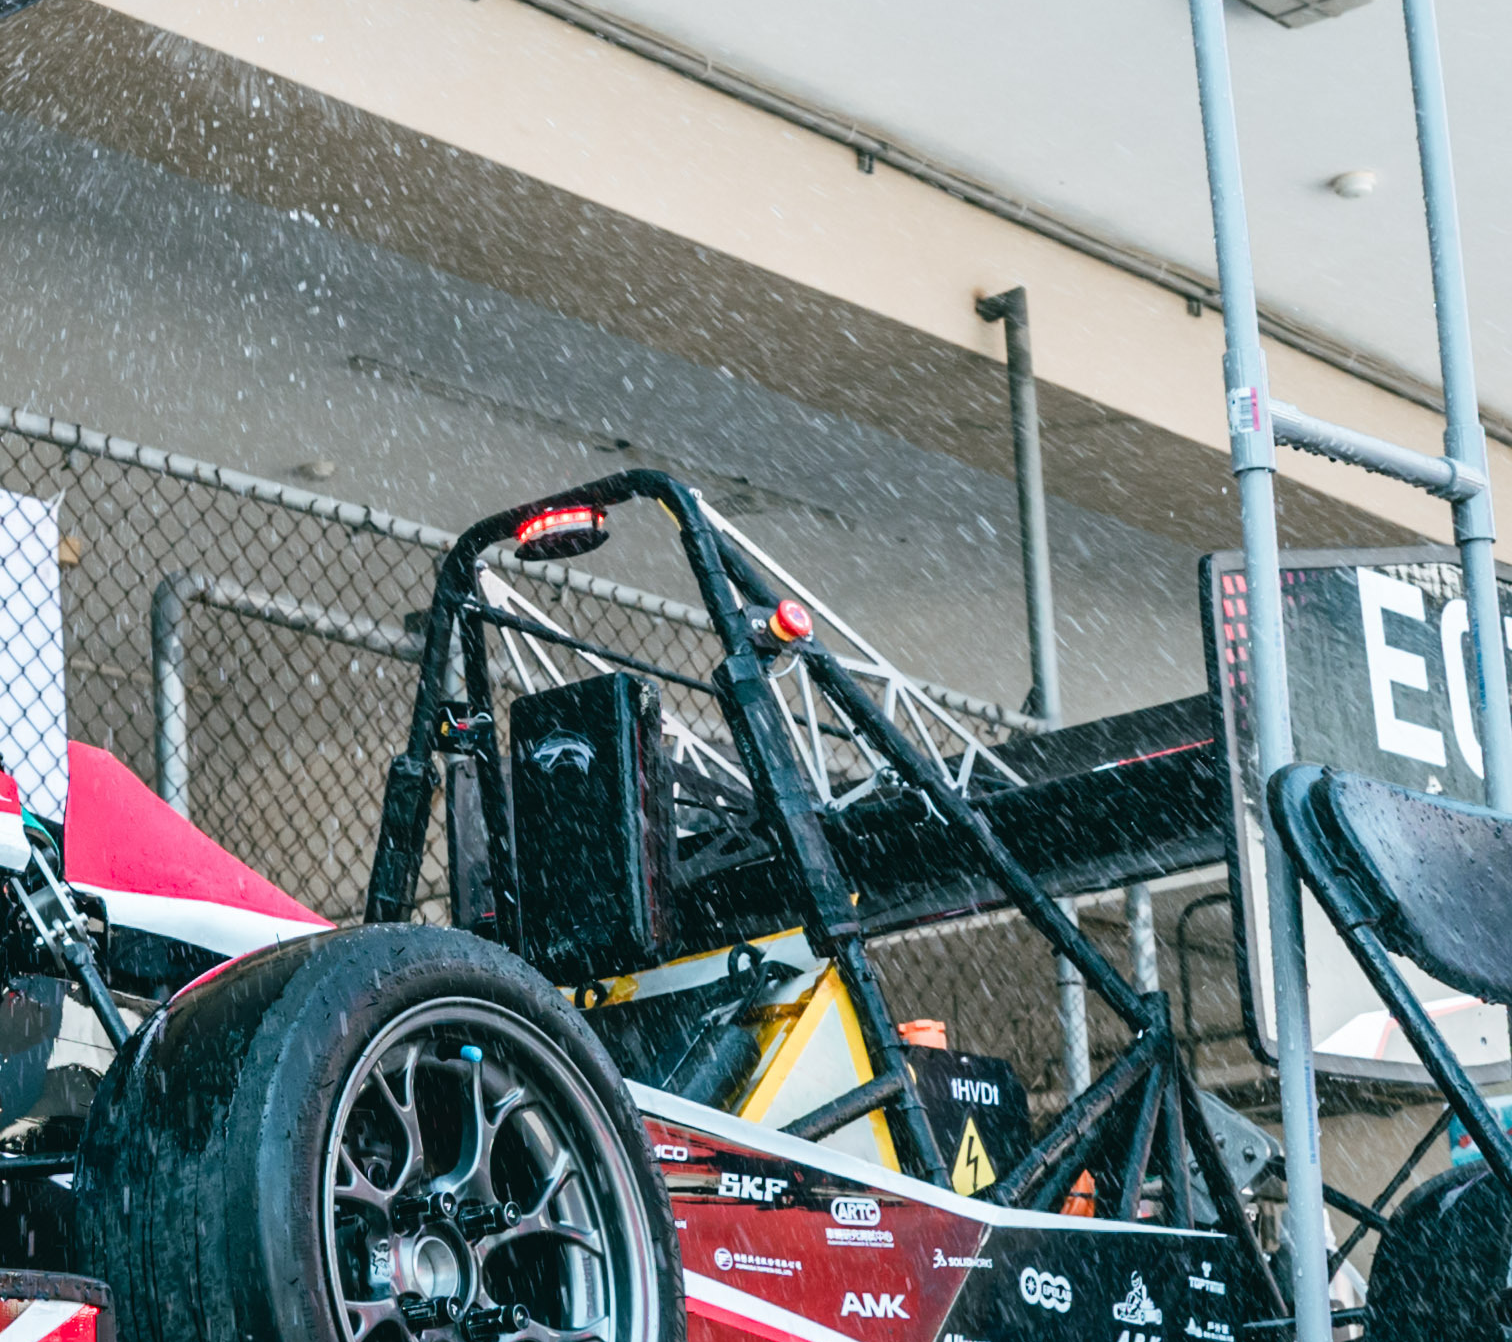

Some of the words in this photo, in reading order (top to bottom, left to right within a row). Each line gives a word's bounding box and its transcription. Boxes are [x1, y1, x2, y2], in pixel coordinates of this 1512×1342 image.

[718, 1172, 789, 1202] SKF
[836, 1202, 877, 1221] ARTC
[840, 1291, 911, 1320] AMK
